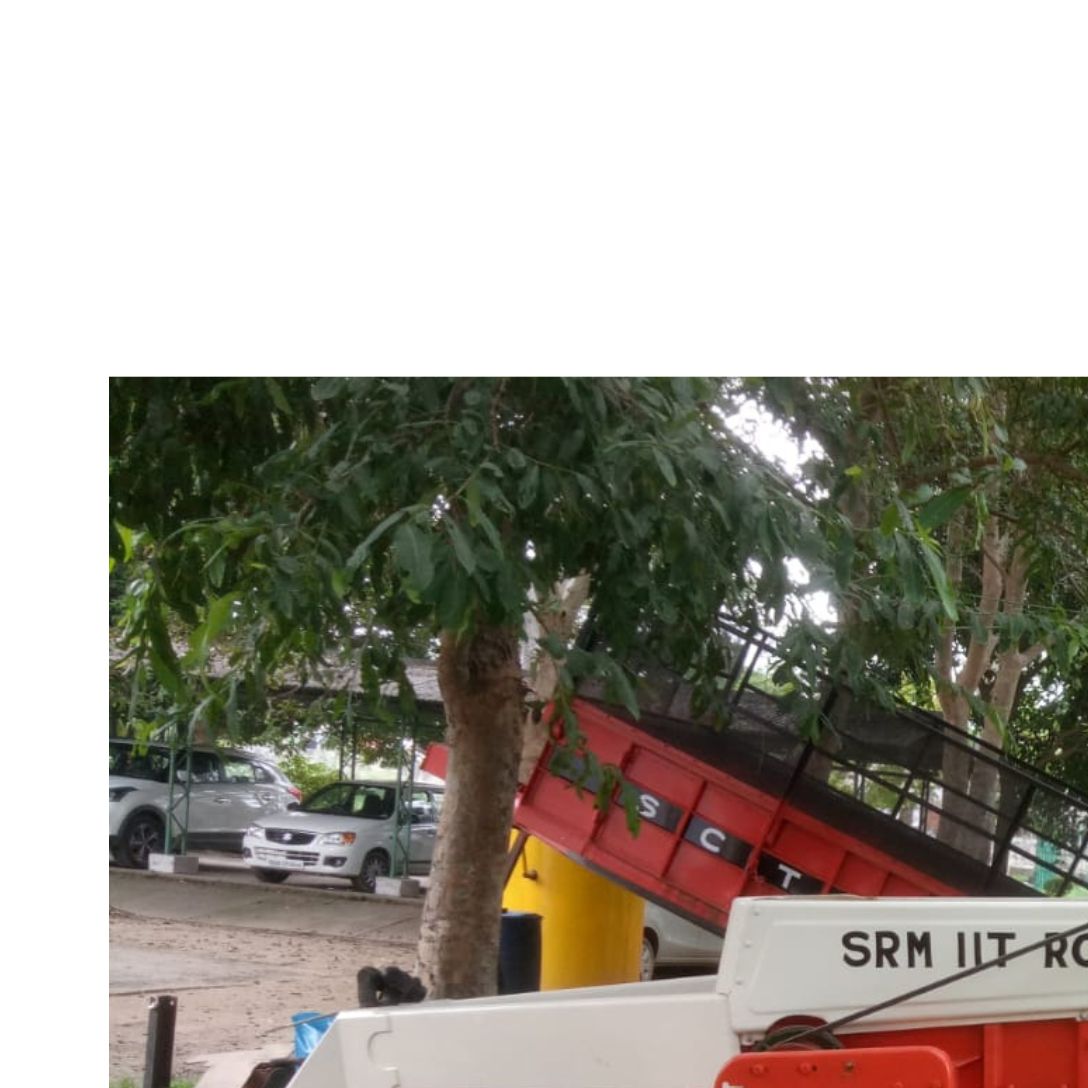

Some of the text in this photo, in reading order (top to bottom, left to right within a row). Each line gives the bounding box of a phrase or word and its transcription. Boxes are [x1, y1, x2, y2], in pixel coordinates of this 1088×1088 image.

[636, 794, 801, 888] S C T
[841, 930, 933, 969] SRM
[957, 931, 1016, 969] IIT
